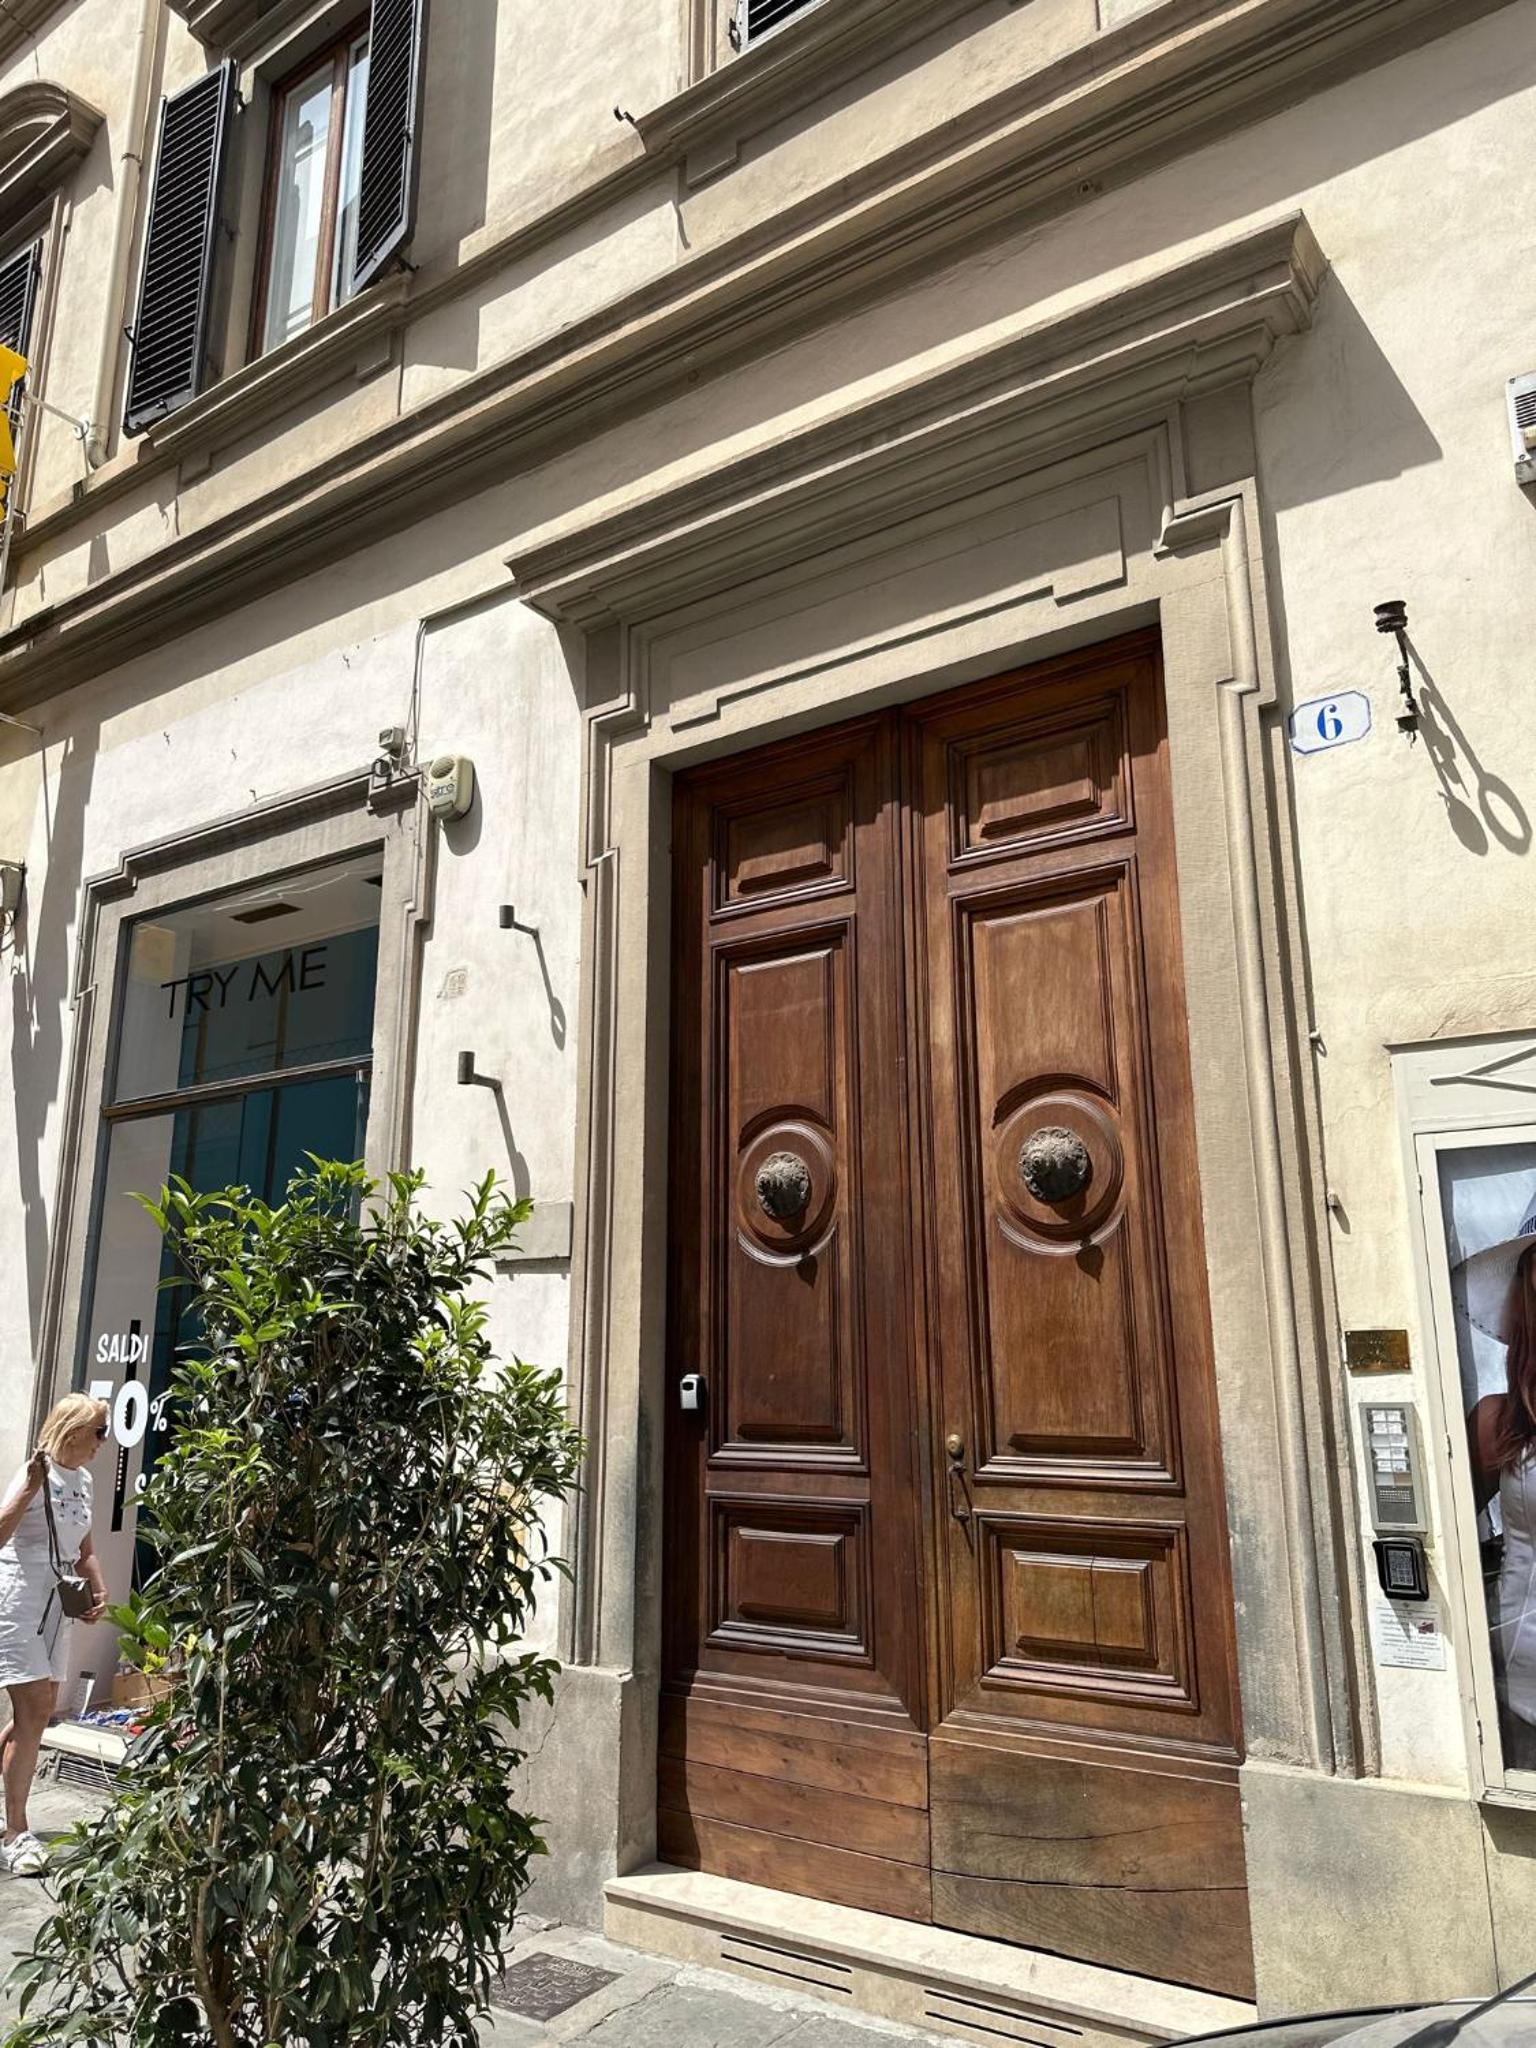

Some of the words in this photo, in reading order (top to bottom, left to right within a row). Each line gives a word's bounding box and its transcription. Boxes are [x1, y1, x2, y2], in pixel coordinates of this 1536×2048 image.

[1317, 704, 1343, 740] 6
[161, 966, 239, 1019] TRY
[248, 946, 327, 1002] ME
[96, 1333, 149, 1364] SALDI
